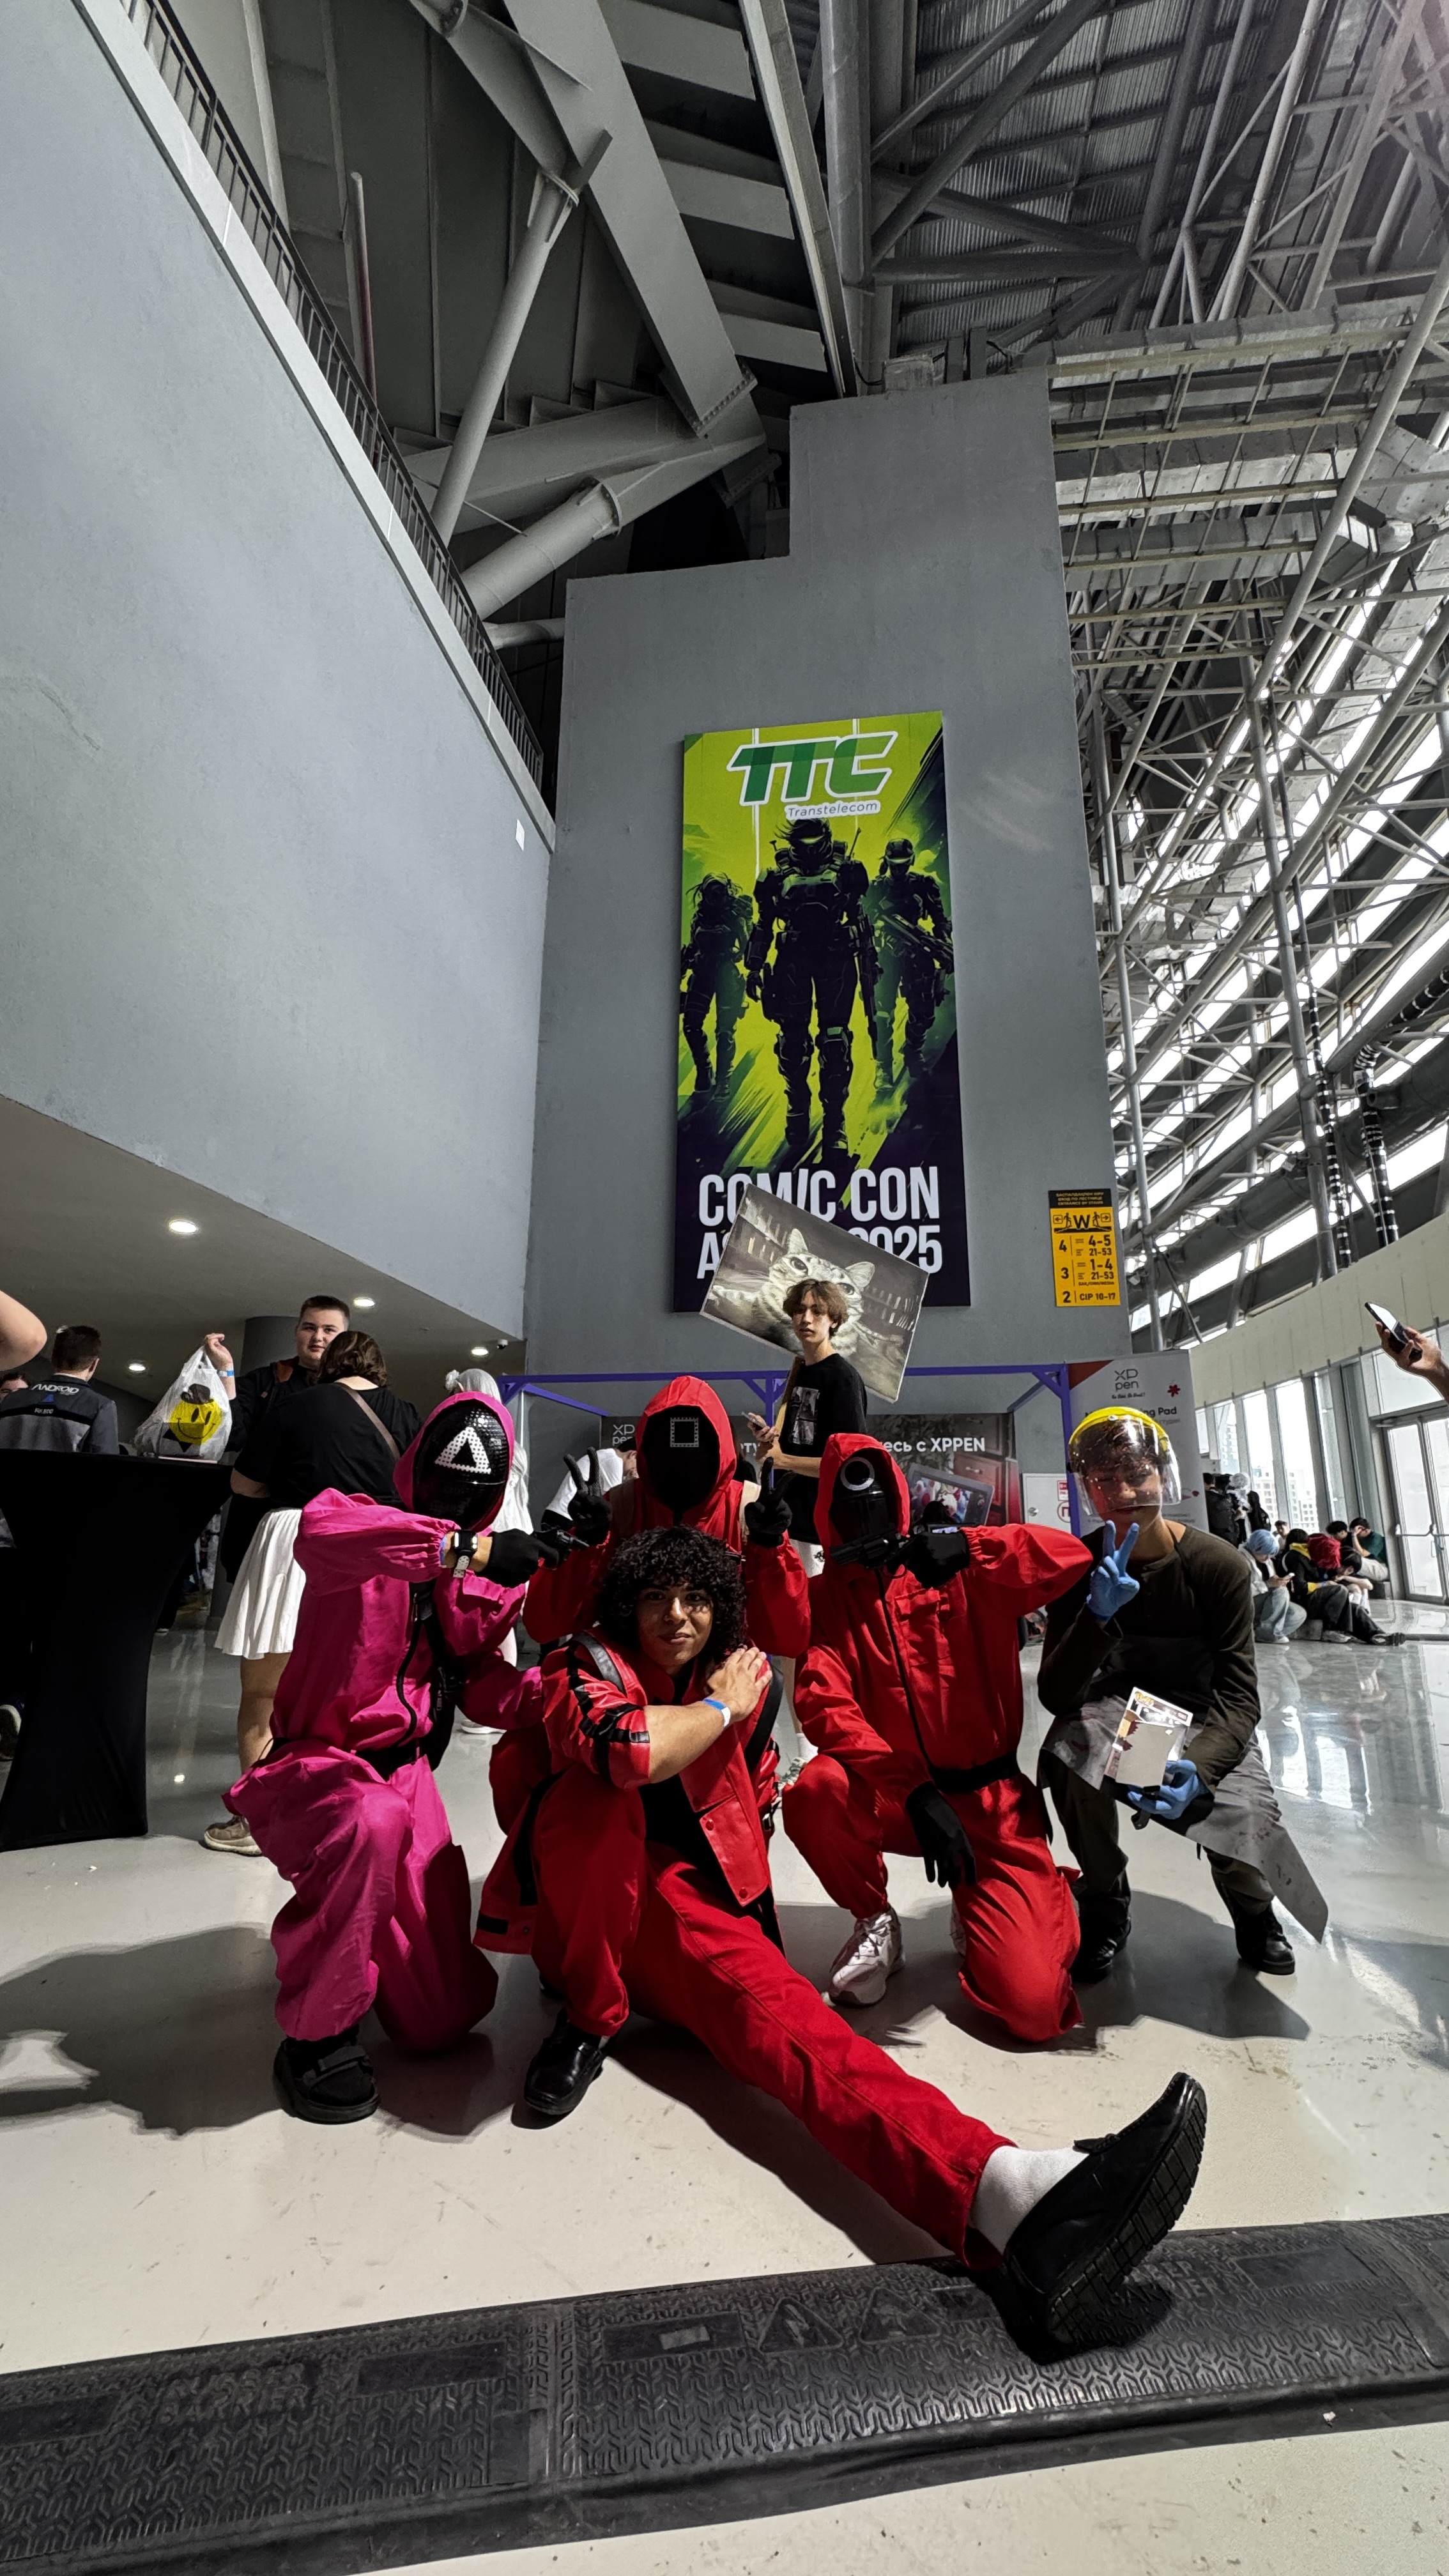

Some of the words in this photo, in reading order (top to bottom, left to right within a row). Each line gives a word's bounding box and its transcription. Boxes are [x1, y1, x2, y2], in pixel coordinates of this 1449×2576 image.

[728, 732, 898, 805] TTC
[788, 802, 877, 818] Transtelecom
[850, 1167, 940, 1222] CON
[1073, 1215, 1090, 1229] W
[1059, 1239, 1067, 1252] 4
[1088, 1234, 1111, 1246] 4-5
[1089, 1247, 1112, 1256] 21-53
[1061, 1267, 1069, 1279] 3
[1091, 1271, 1114, 1280] 21-53
[1062, 1291, 1071, 1303] 2
[1114, 1368, 1138, 1381] XP
[1115, 1381, 1138, 1392] pen
[1158, 1406, 1177, 1416] Pad
[613, 1424, 635, 1436] XP
[612, 1436, 633, 1447] pe
[916, 1441, 926, 1452] с
[930, 1438, 985, 1452] XPPEN
